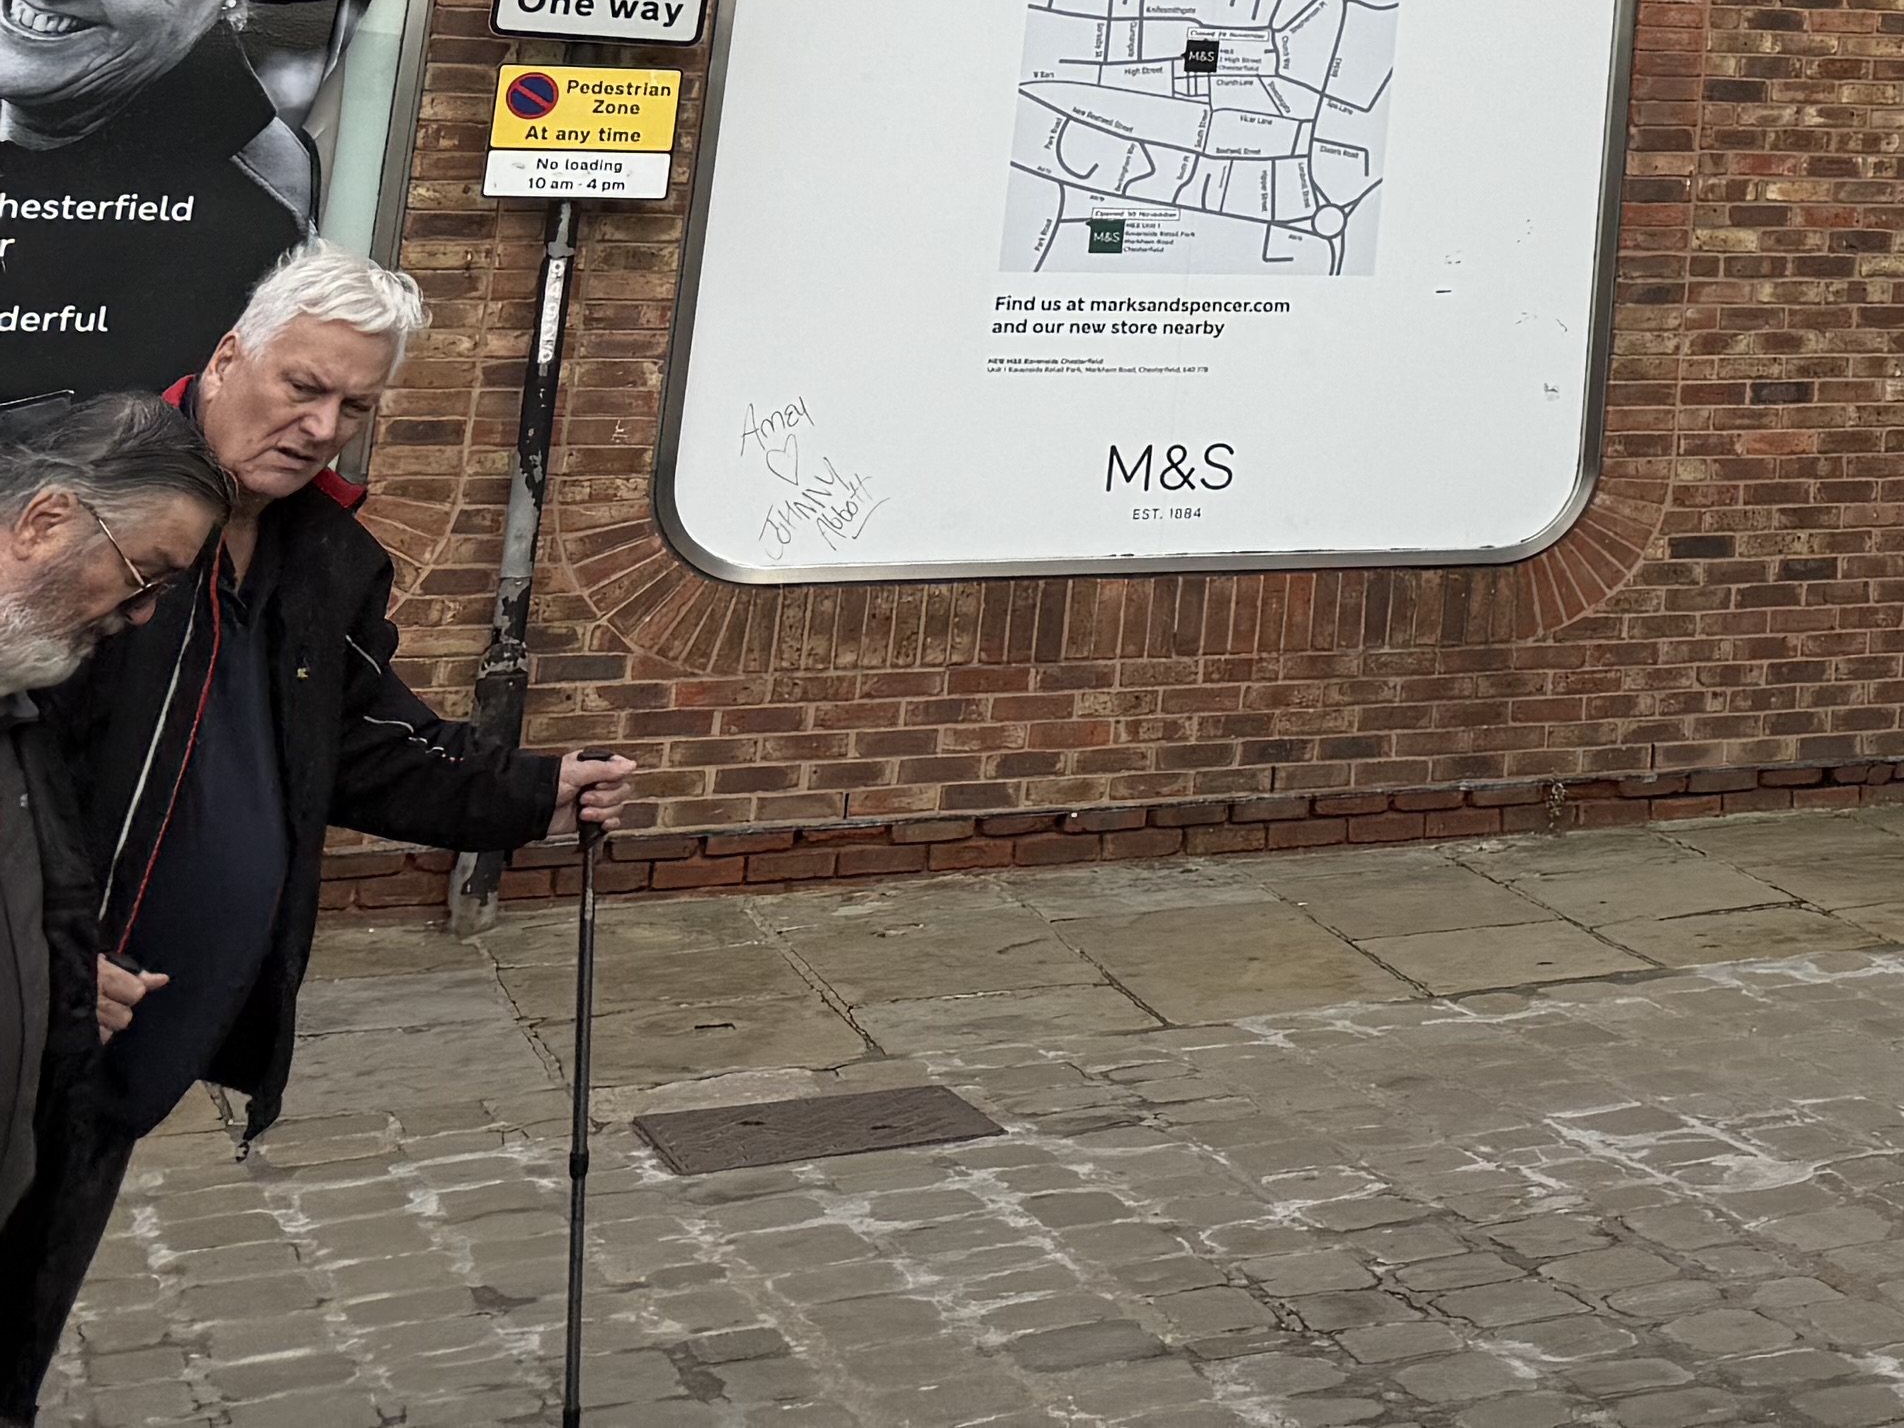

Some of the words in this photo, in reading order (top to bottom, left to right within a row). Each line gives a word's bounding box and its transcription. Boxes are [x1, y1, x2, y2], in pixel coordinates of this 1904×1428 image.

[1188, 51, 1215, 62] M&S
[566, 79, 672, 97] Pedestrian
[592, 99, 640, 115] Zone
[525, 126, 548, 140] At
[555, 129, 590, 144] any
[598, 128, 641, 142] time
[536, 158, 558, 170] No
[565, 159, 623, 173] loading
[528, 177, 546, 190] 10
[550, 180, 573, 190] am
[586, 178, 597, 190] 4
[601, 180, 625, 192] pm
[1093, 232, 1120, 243] M&S
[995, 295, 1036, 312] Find
[1041, 299, 1061, 312] us
[1066, 298, 1085, 312] at
[1090, 297, 1291, 316] marksandspencer.com
[992, 319, 1027, 334] and
[1032, 322, 1064, 335] our
[1069, 322, 1106, 335] new
[1111, 321, 1158, 335] store
[1163, 320, 1225, 339] nearby
[1105, 442, 1235, 492] M&S
[1132, 508, 1163, 520] EST.
[1170, 507, 1202, 519] 1884
